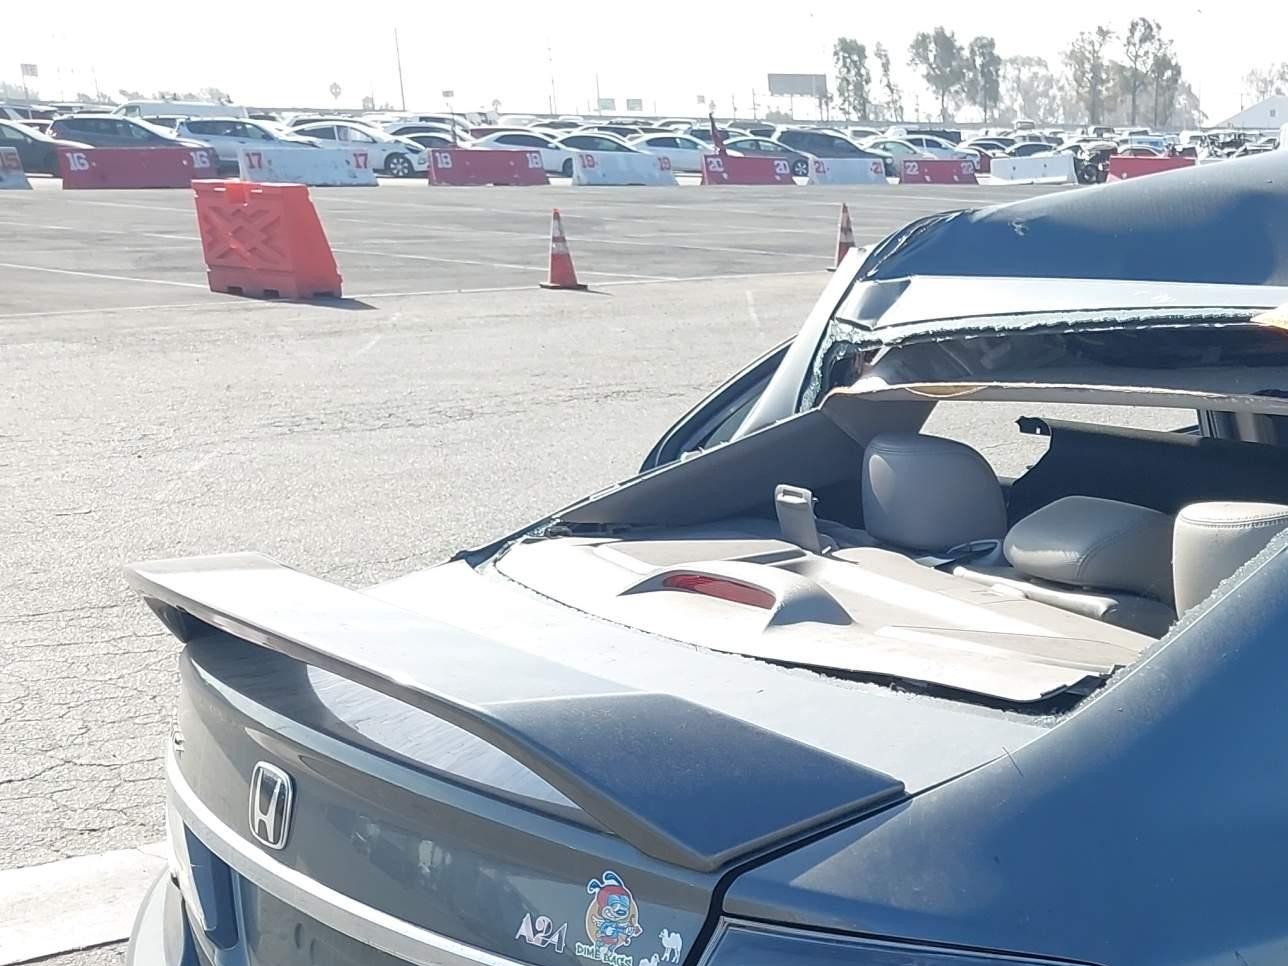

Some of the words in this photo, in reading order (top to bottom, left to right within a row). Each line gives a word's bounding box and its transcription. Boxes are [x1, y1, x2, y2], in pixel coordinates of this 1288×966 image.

[65, 152, 89, 171] 16
[190, 151, 210, 168] 16
[245, 152, 262, 169] 17
[353, 152, 369, 169] 17
[435, 152, 453, 168] 18
[526, 153, 543, 168] 18
[579, 154, 596, 168] 19
[707, 157, 724, 172] 20
[774, 159, 790, 174] 20
[813, 160, 826, 174] 21
[904, 162, 919, 175] 22
[961, 162, 974, 175] 22
[576, 944, 601, 959] DIME
